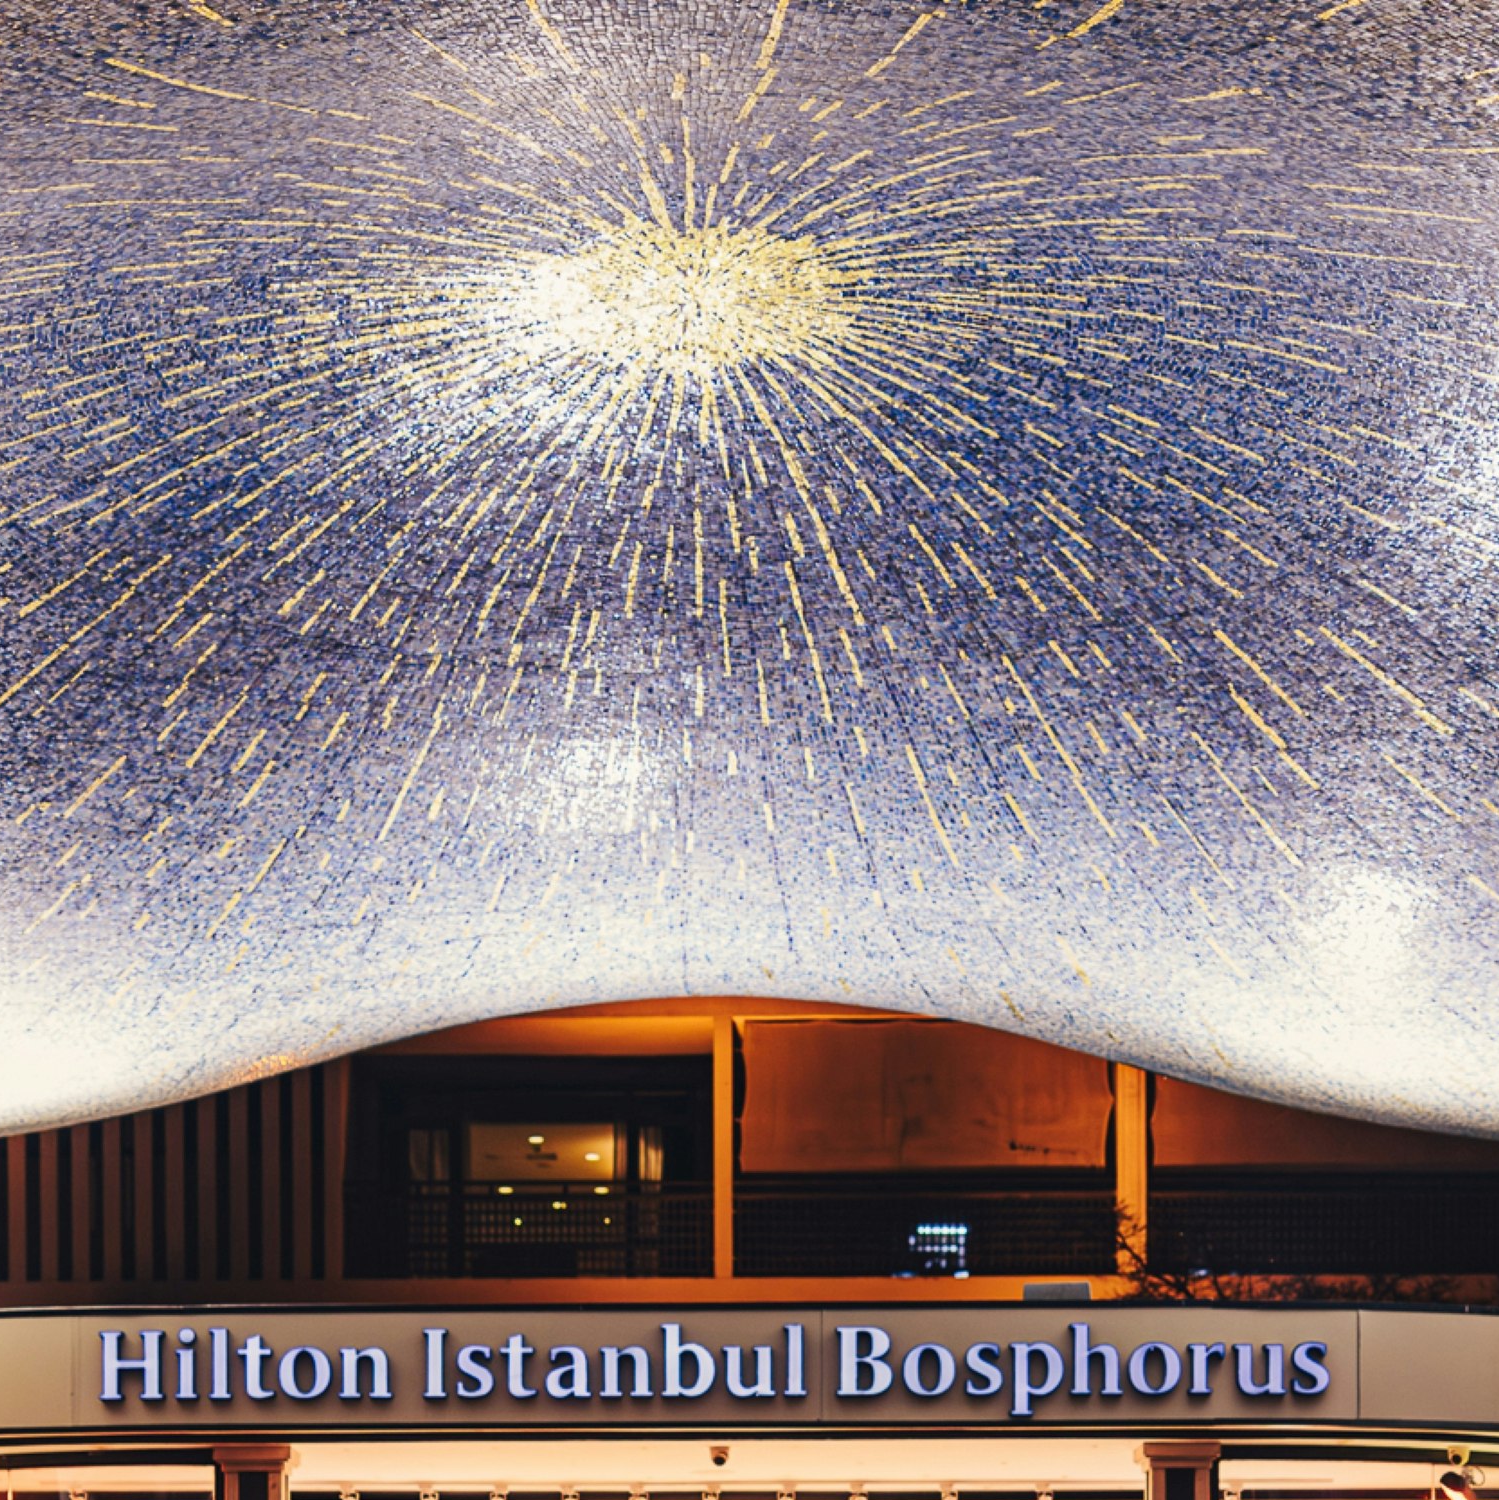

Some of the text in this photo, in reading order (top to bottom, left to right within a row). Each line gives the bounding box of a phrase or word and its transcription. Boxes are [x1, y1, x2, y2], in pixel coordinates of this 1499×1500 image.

[99, 1322, 1332, 1417] Hilton Istanbul Bosphorus
